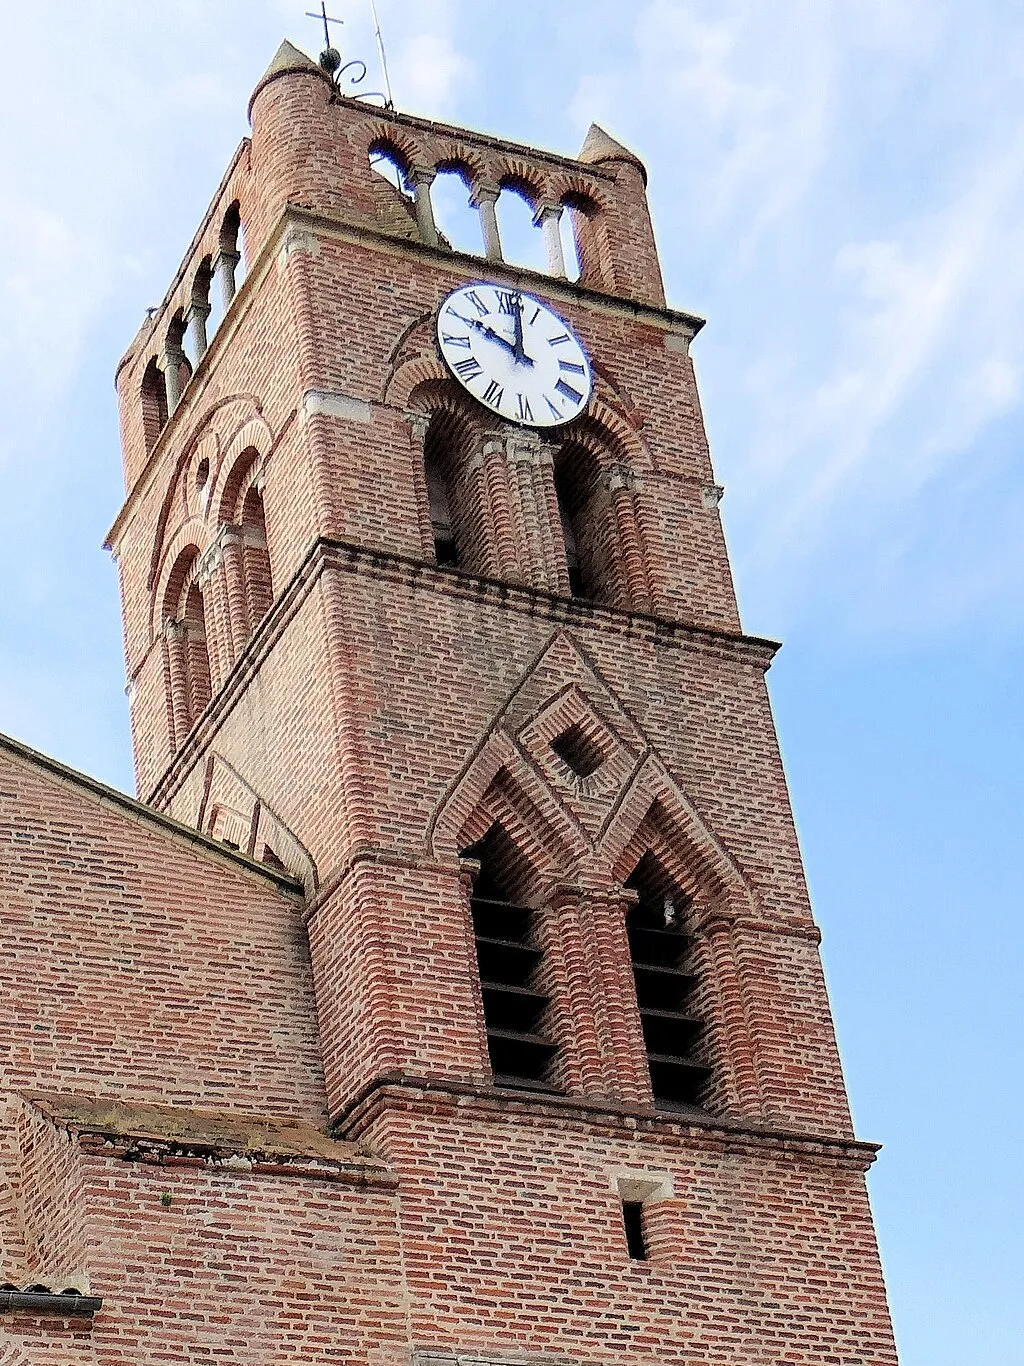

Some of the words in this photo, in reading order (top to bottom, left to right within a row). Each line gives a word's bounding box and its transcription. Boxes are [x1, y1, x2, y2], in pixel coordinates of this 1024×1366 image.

[464, 290, 491, 317] XI
[446, 306, 475, 329] X
[529, 308, 541, 327] I
[442, 331, 472, 350] IX
[546, 333, 571, 347] II
[452, 356, 484, 383] VIII
[482, 378, 505, 409] VII
[516, 394, 534, 422] VI
[542, 394, 564, 421] V
